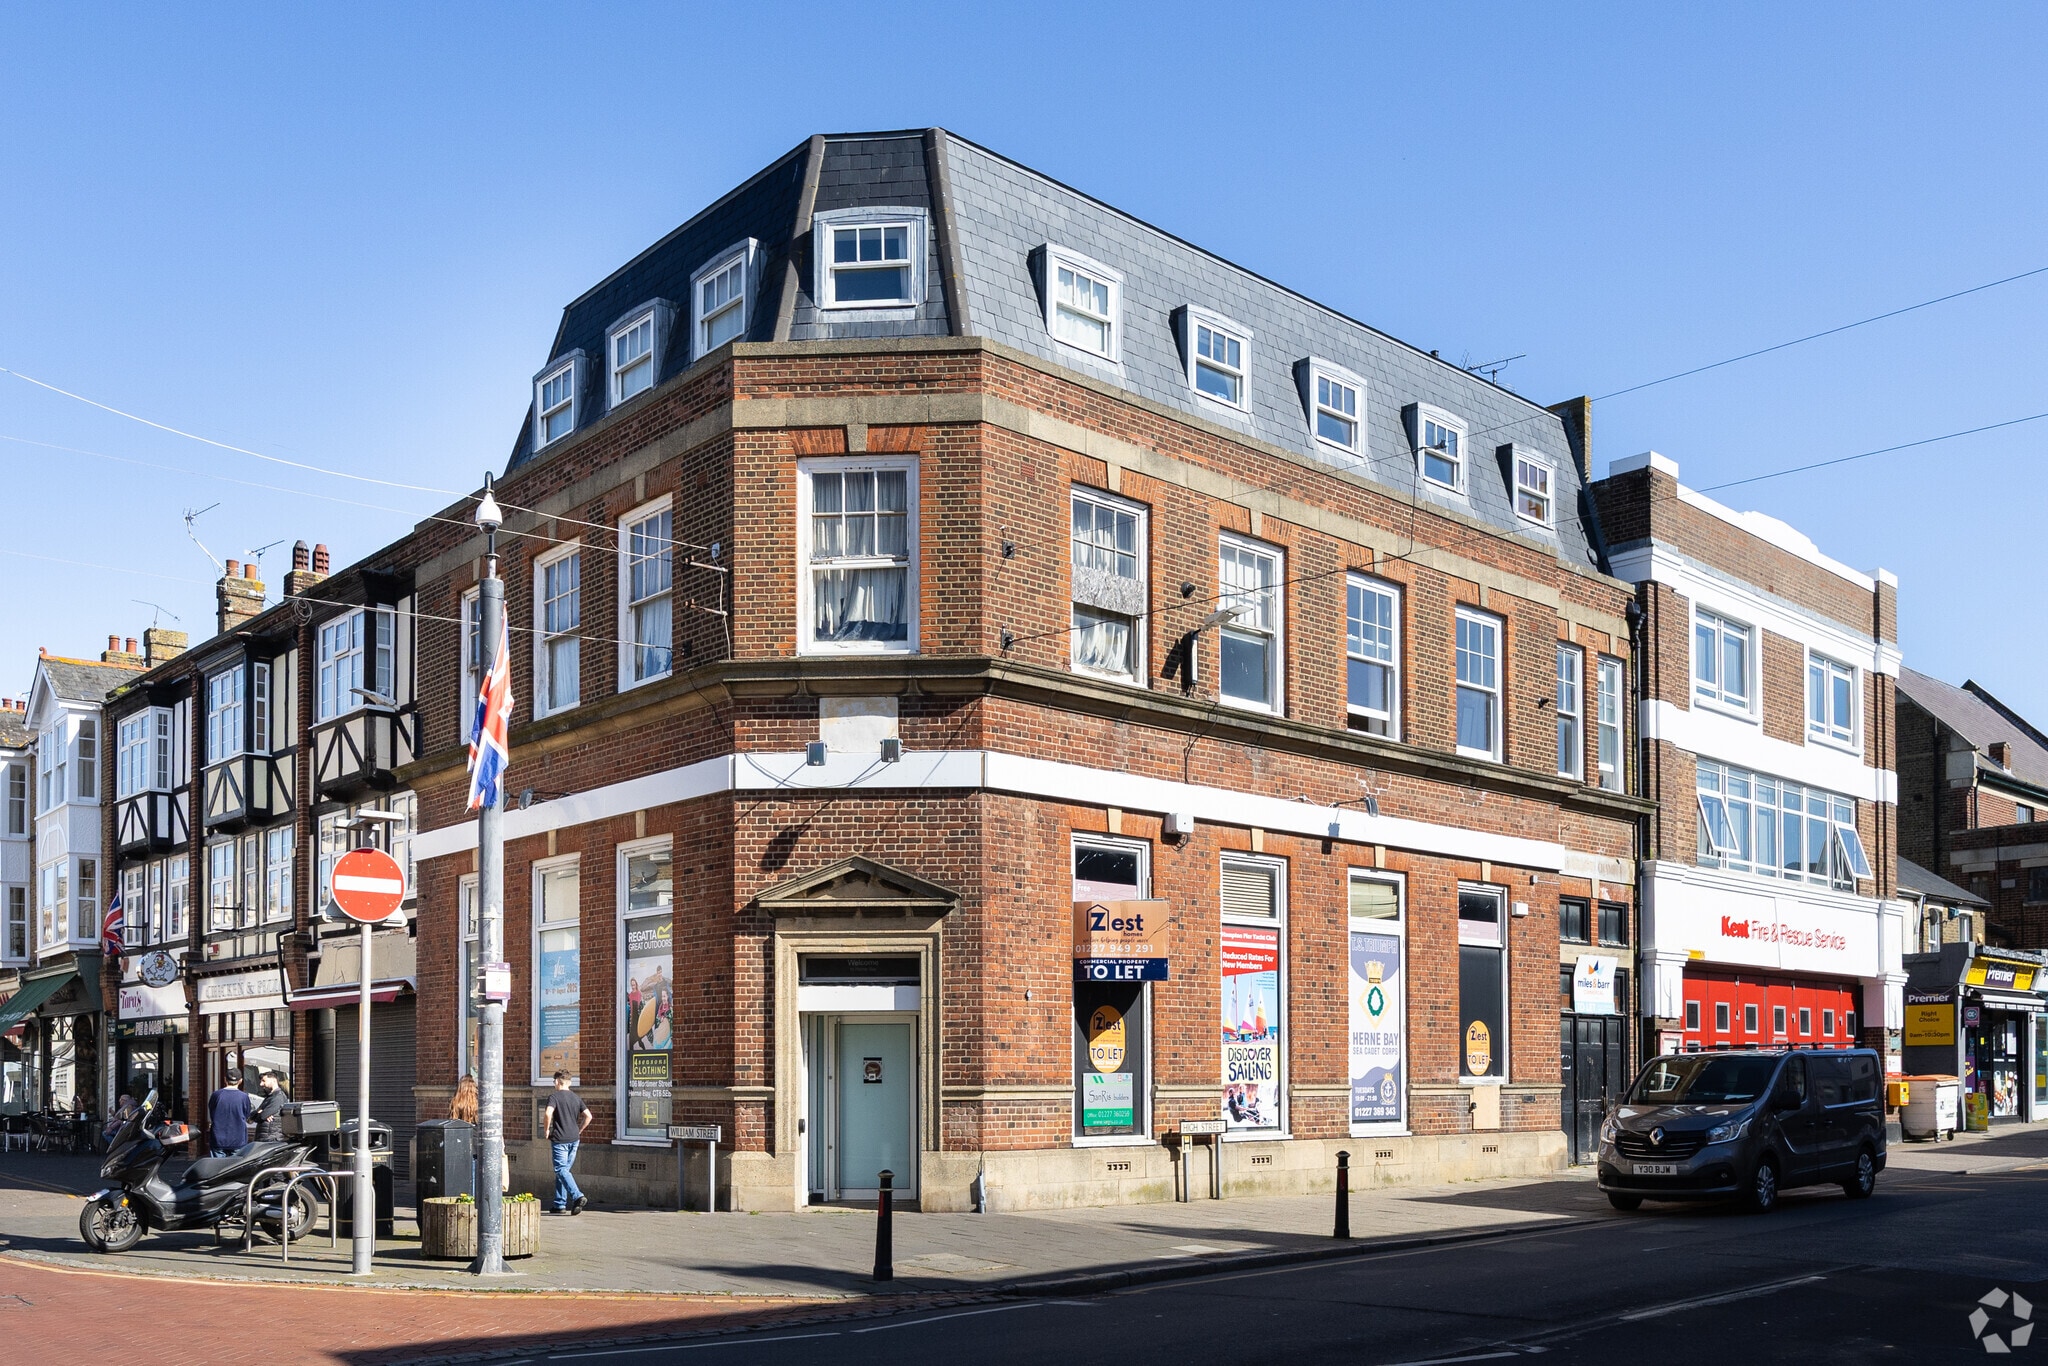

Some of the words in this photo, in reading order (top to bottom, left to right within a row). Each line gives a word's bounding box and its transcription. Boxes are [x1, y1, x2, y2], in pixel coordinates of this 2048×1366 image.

[1090, 912, 1144, 932] Zest
[629, 929, 657, 942] REGATTA
[1721, 915, 1749, 939] Kent
[1752, 920, 1769, 942] Fire
[1771, 923, 1778, 942] &
[1780, 923, 1813, 946] Rescue
[1815, 928, 1846, 950] Service
[629, 941, 643, 951] GREAT
[643, 939, 673, 949] OUTDOORS
[1075, 944, 1105, 953] 01227
[1109, 944, 1131, 953] 949
[1135, 944, 1153, 953] 291
[1222, 952, 1248, 960] Reduced
[1248, 953, 1265, 961] Rates
[1222, 960, 1236, 968] New
[1236, 961, 1262, 970] Members
[1084, 964, 1109, 979] TO
[1115, 965, 1144, 979] LET
[1986, 967, 2015, 982] Premier
[206, 982, 244, 999] CHICKEN
[247, 982, 254, 994] &
[1908, 994, 1949, 1002] Premier
[1096, 1016, 1121, 1031] Zest
[1353, 1032, 1381, 1046] HERNE
[1384, 1033, 1398, 1046] BAY
[1471, 1030, 1487, 1040] Zest
[1091, 1048, 1104, 1059] TO
[1108, 1049, 1123, 1059] LET
[1353, 1047, 1363, 1055] SEA
[1364, 1047, 1380, 1055] CADET
[1468, 1055, 1476, 1064] TO
[1479, 1055, 1488, 1064] LET
[634, 1066, 666, 1075] CLOTHING
[1355, 1107, 1372, 1116] 01227
[1183, 1123, 1198, 1132] HIGH
[1201, 1122, 1224, 1131] STREET
[670, 1127, 694, 1138] WILLIAM
[696, 1128, 718, 1138] STREET
[1638, 1165, 1653, 1173] Y30
